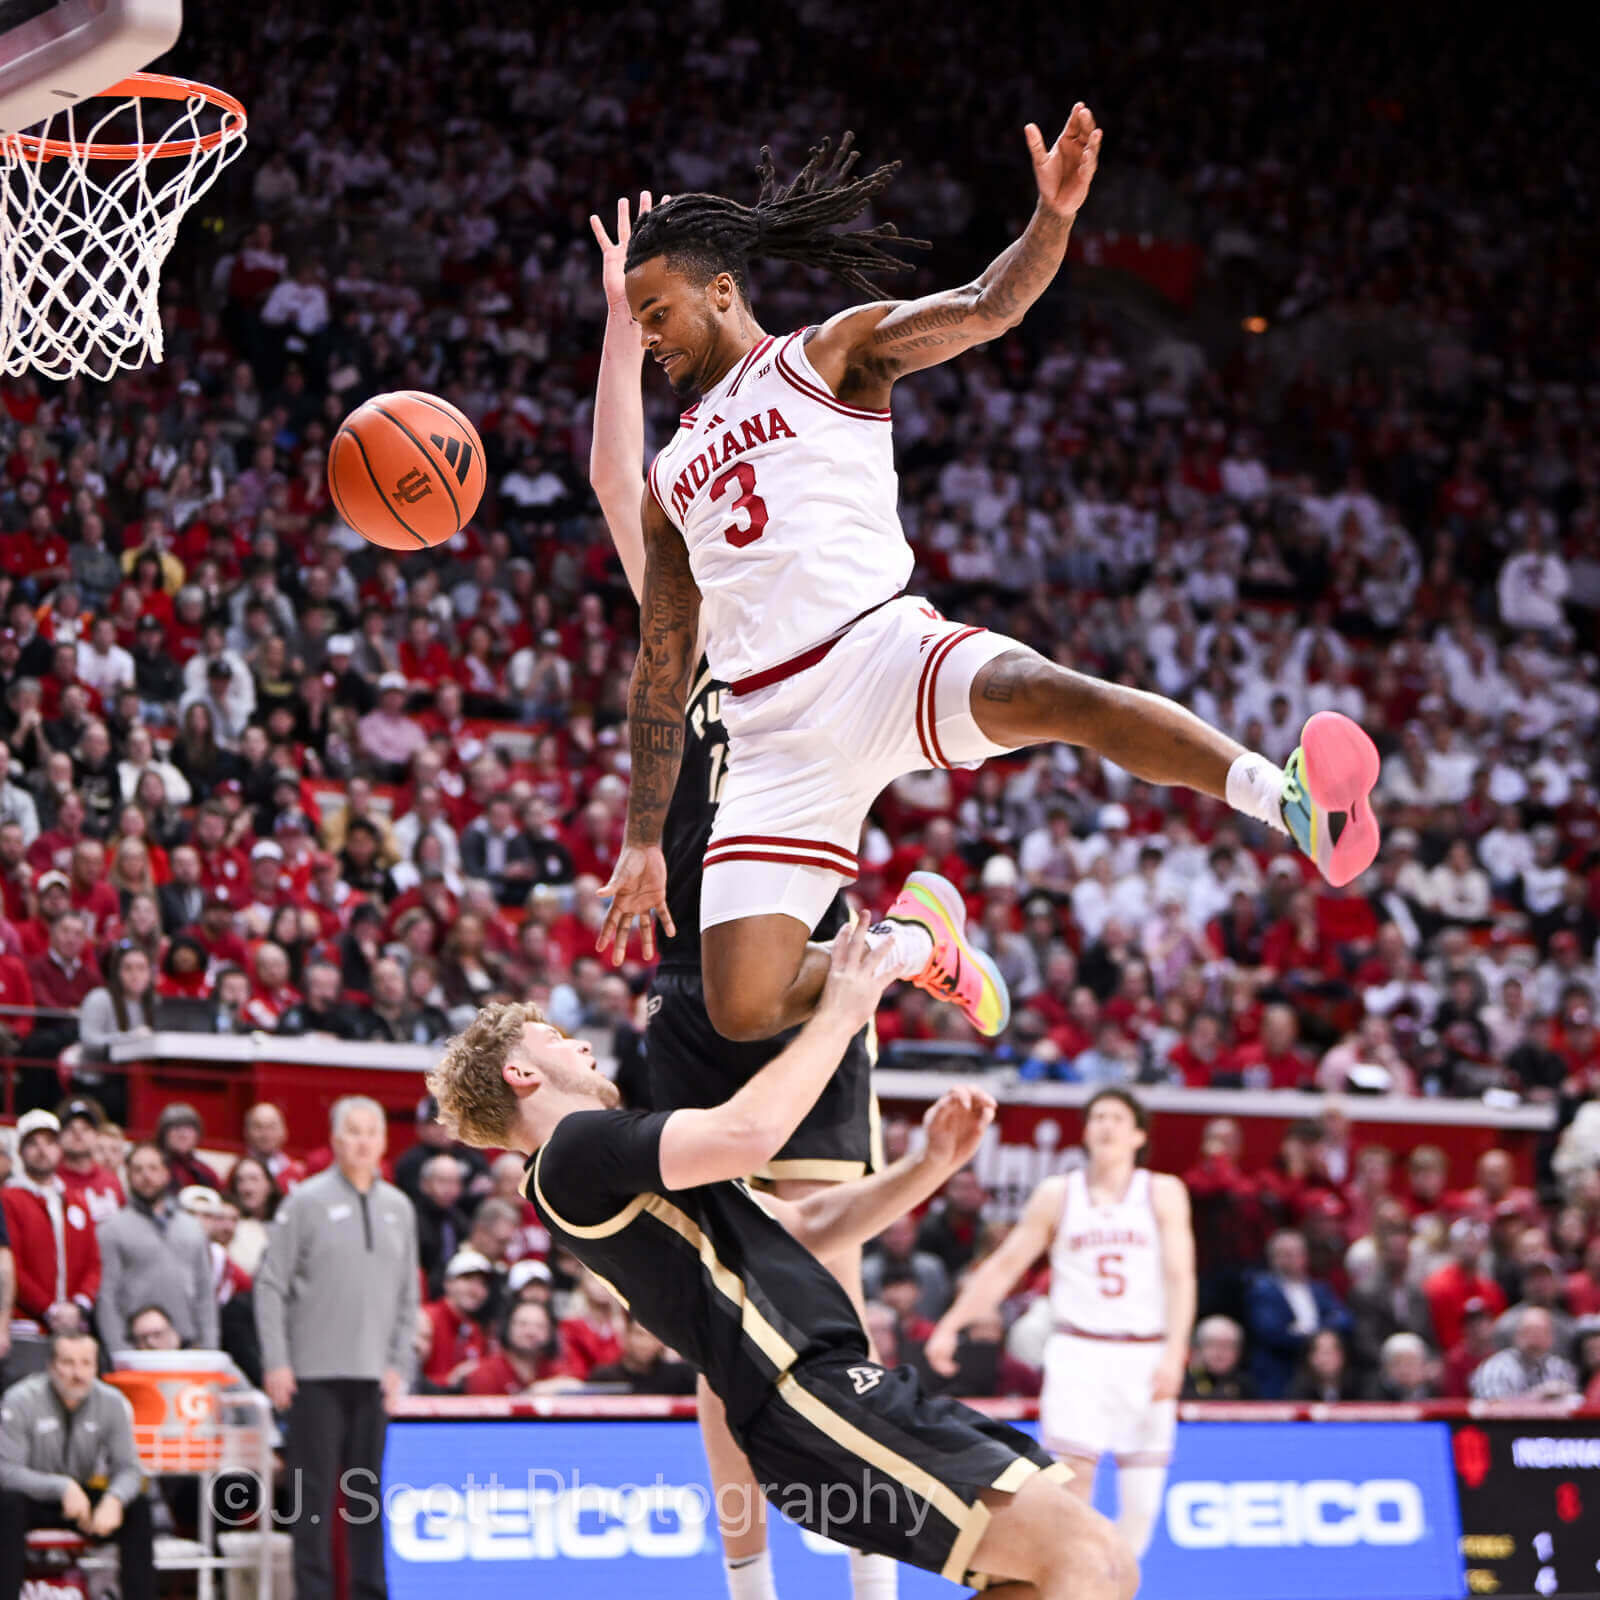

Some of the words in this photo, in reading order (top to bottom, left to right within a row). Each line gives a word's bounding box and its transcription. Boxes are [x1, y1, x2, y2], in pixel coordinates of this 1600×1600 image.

[671, 407, 797, 527] INDIANA
[709, 461, 769, 549] 3
[1097, 1253, 1126, 1299] 5
[180, 1386, 209, 1420] G
[390, 1487, 705, 1561] GEICO
[1166, 1479, 1425, 1549] GEICO
